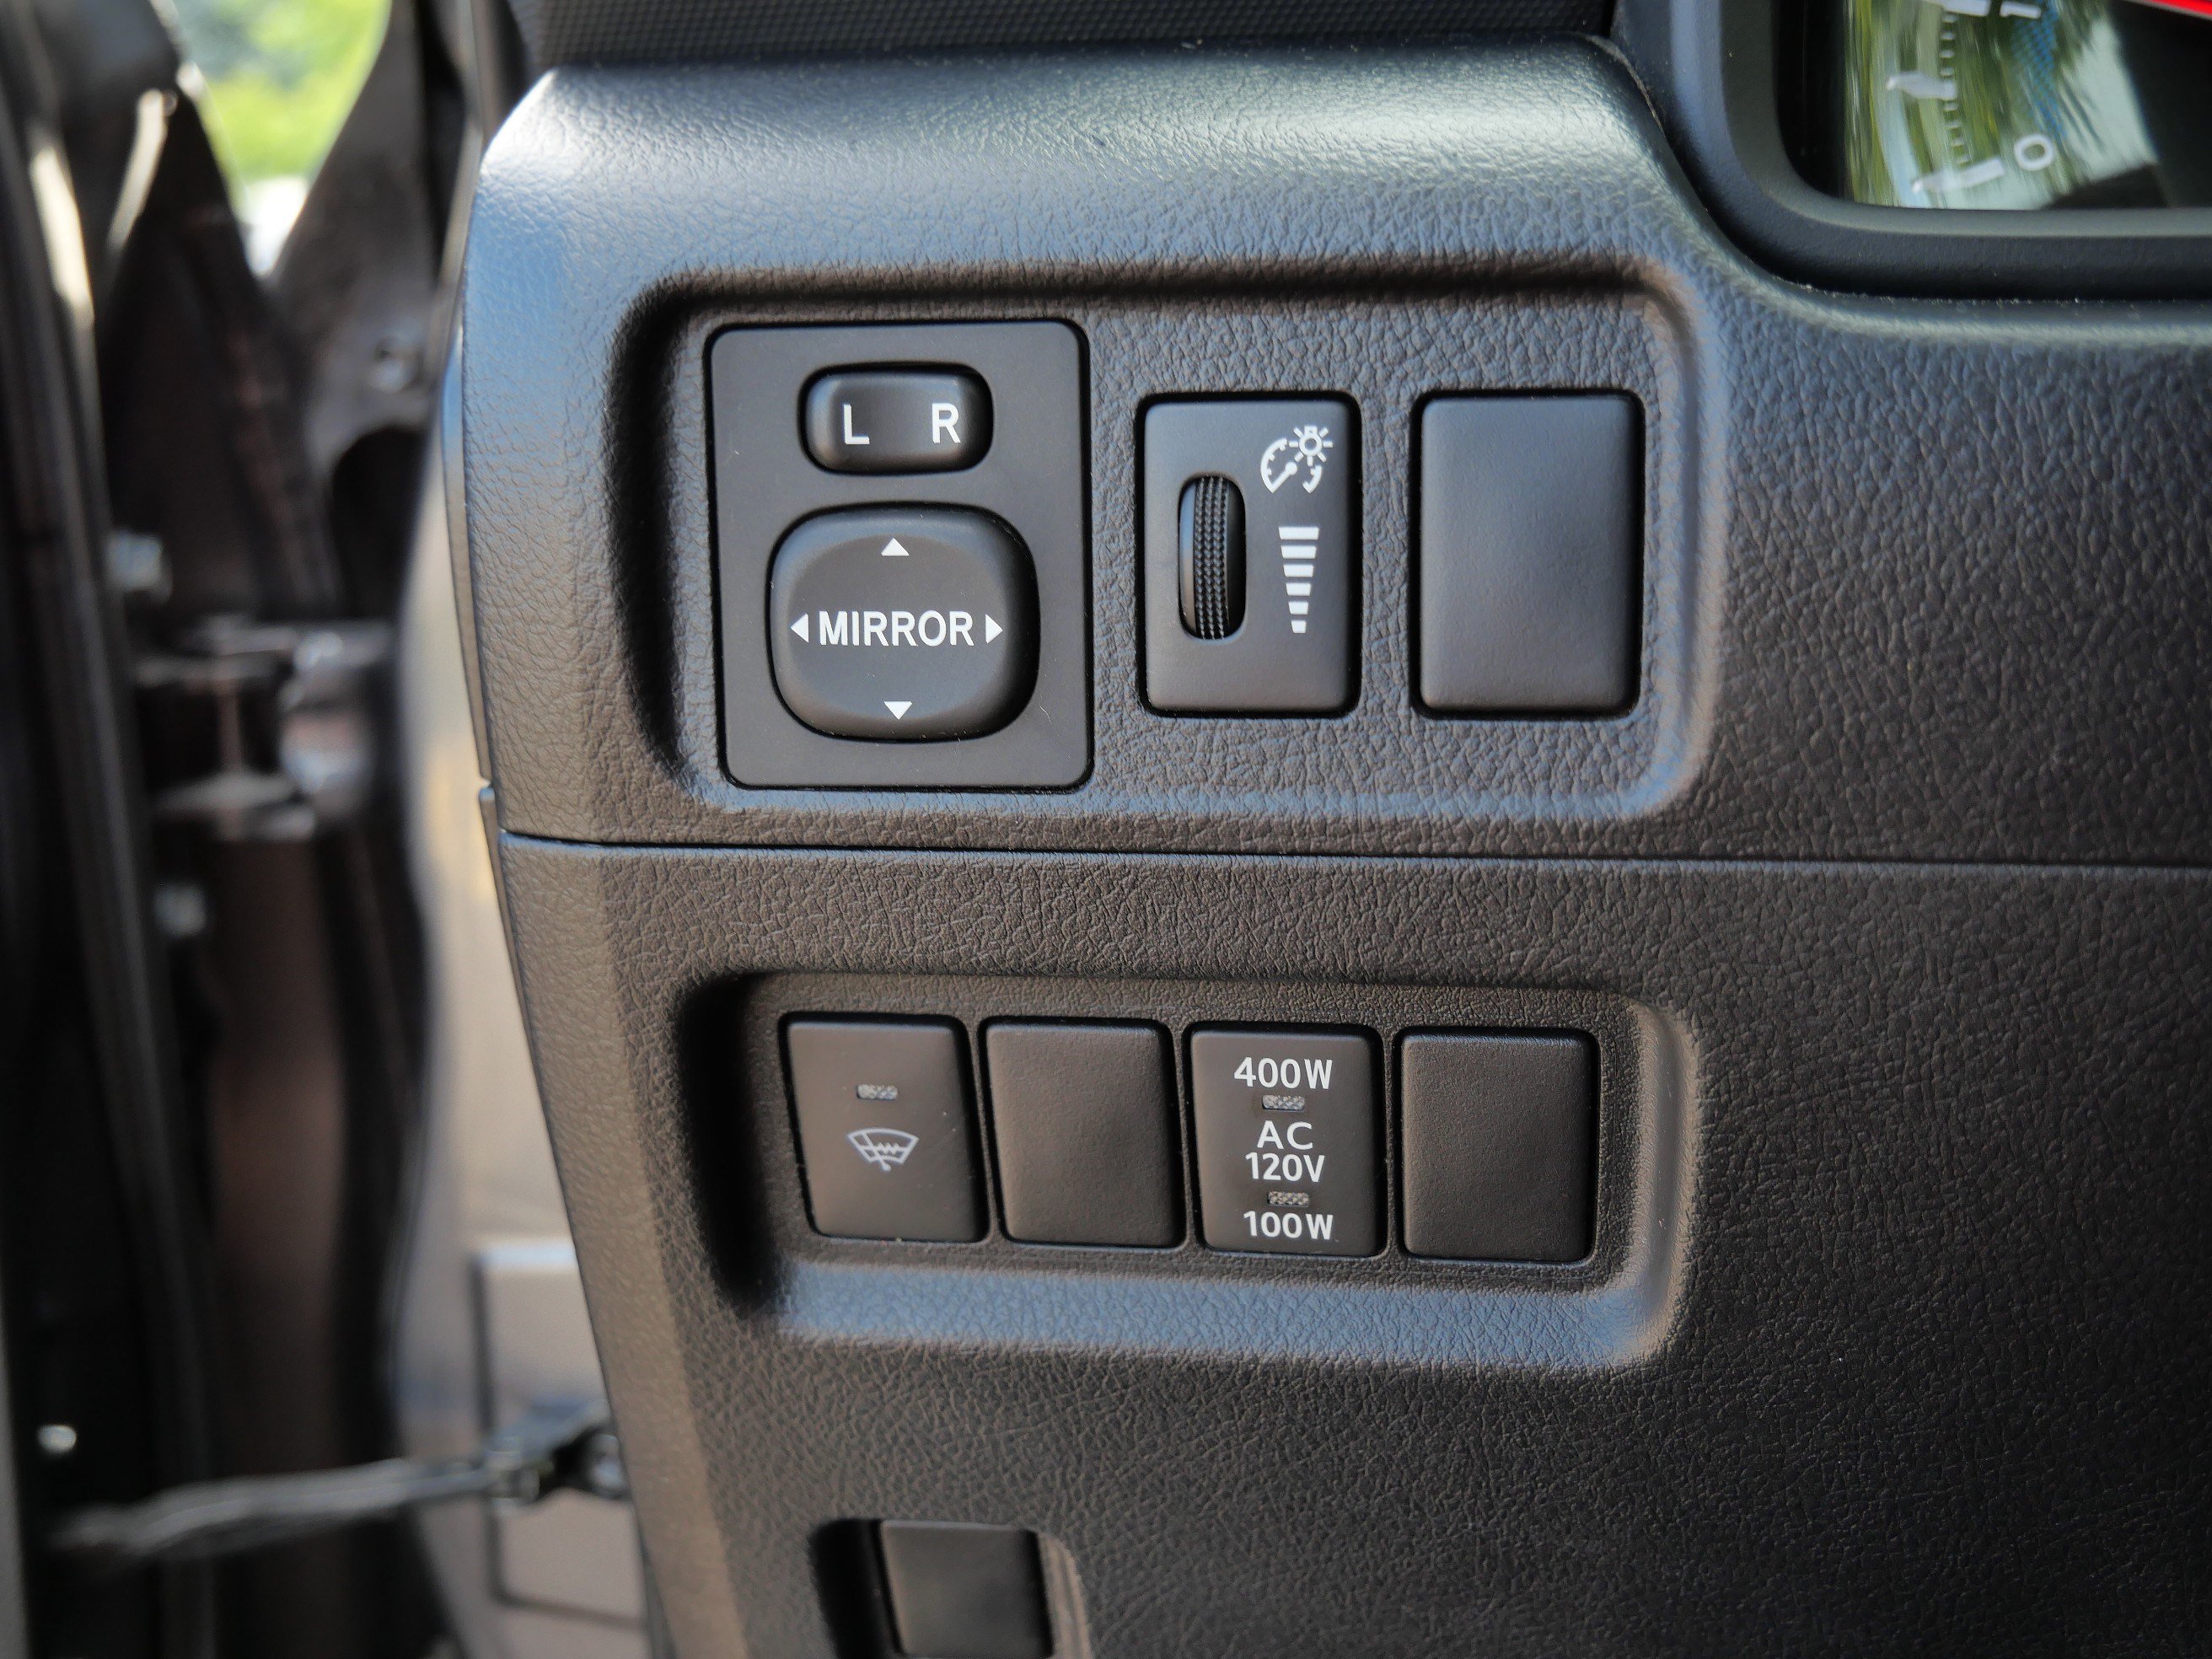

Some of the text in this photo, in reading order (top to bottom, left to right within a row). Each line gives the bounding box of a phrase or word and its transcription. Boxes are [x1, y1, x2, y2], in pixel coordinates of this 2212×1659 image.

[2014, 134, 2054, 171] 0
[844, 402, 961, 444] L R
[819, 610, 974, 647] MIRROR
[1233, 1056, 1333, 1089] 400W
[1257, 1119, 1313, 1151] AC
[1245, 1152, 1325, 1182] 120V
[1243, 1211, 1334, 1239] 100W
